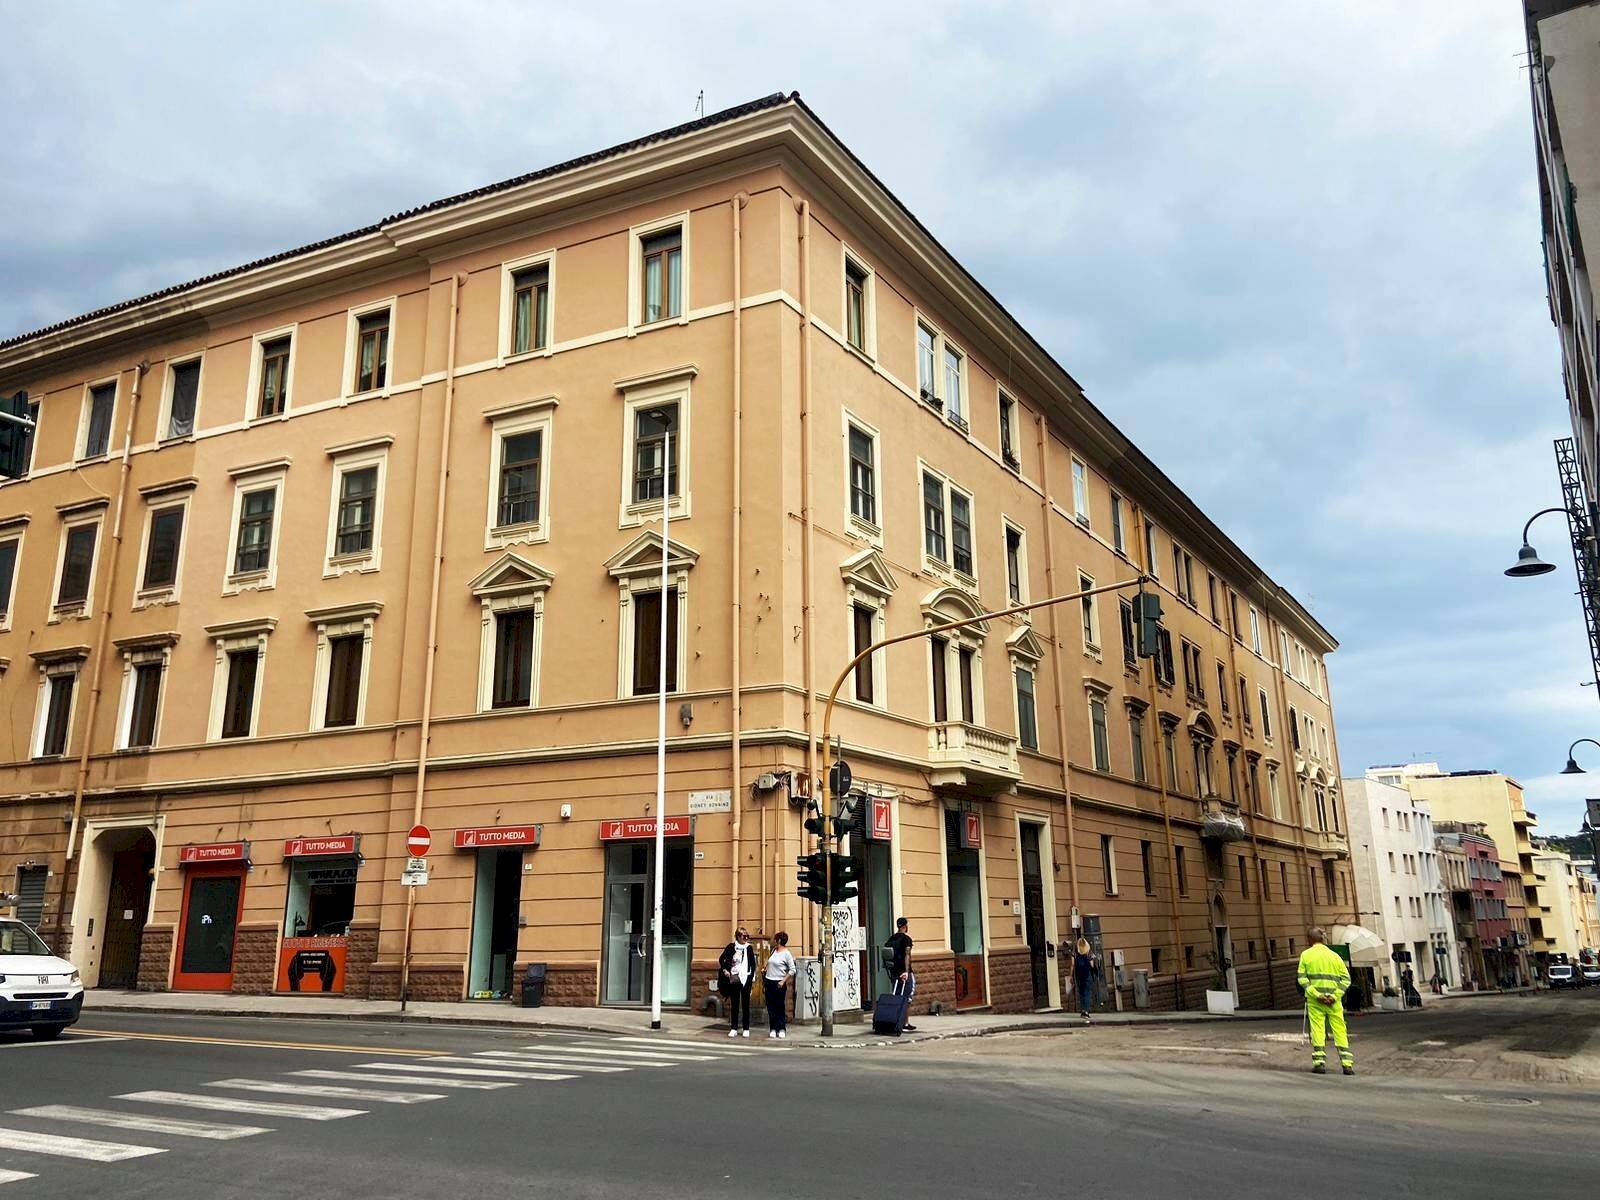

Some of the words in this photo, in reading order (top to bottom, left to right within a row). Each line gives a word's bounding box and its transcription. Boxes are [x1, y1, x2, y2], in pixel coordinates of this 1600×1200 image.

[627, 823, 653, 833] TUTTO
[654, 822, 679, 832] MDIA
[480, 832, 502, 841] TUTTO
[503, 831, 526, 840] MEDIA
[305, 842, 325, 850] TUTTO
[325, 841, 346, 849] MEDIA
[199, 849, 217, 857] TUTTO
[217, 848, 236, 856] MEDIA
